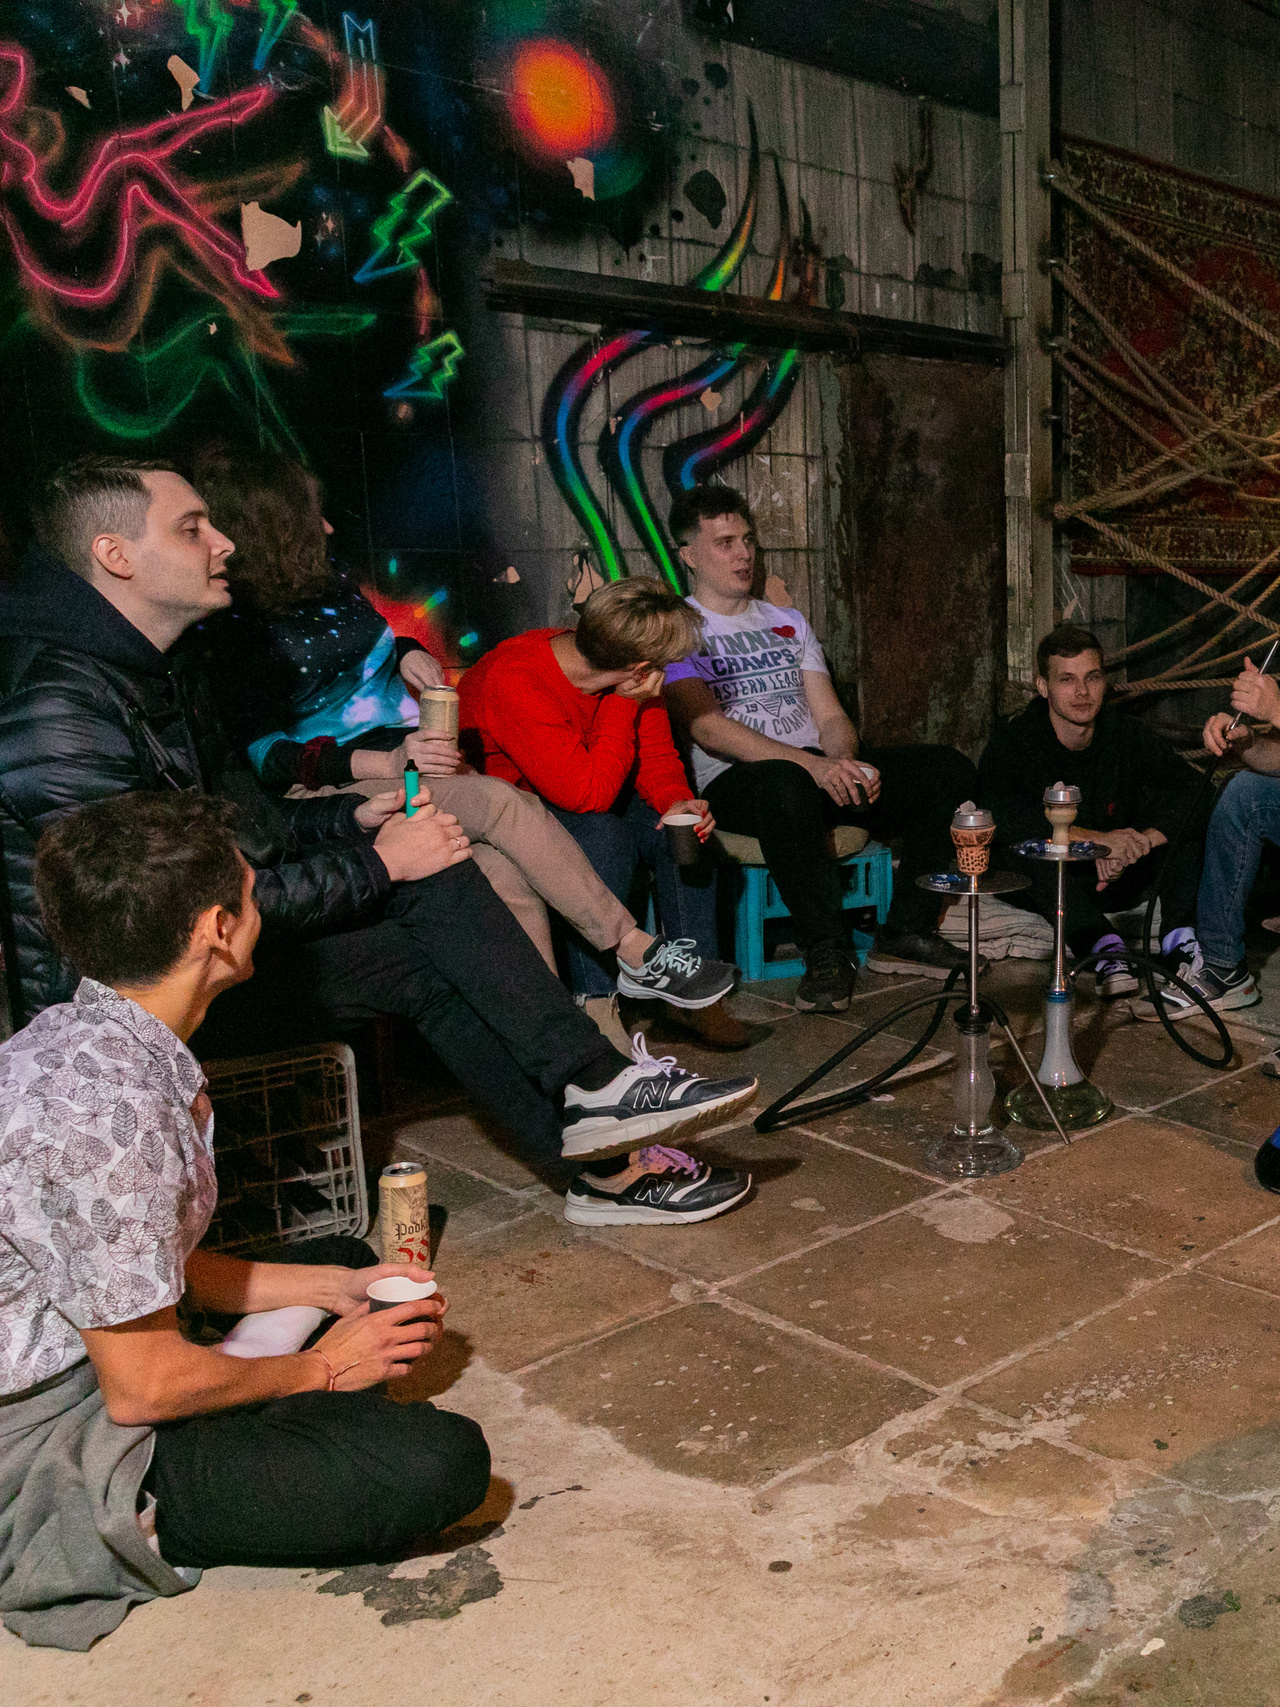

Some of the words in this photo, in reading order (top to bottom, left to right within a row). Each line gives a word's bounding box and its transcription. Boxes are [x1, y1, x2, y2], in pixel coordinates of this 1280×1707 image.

[711, 648, 796, 677] CHAMPS
[710, 677, 767, 701] ASTERN
[745, 703, 758, 714] 19
[633, 1081, 670, 1109] N
[635, 1177, 674, 1205] N
